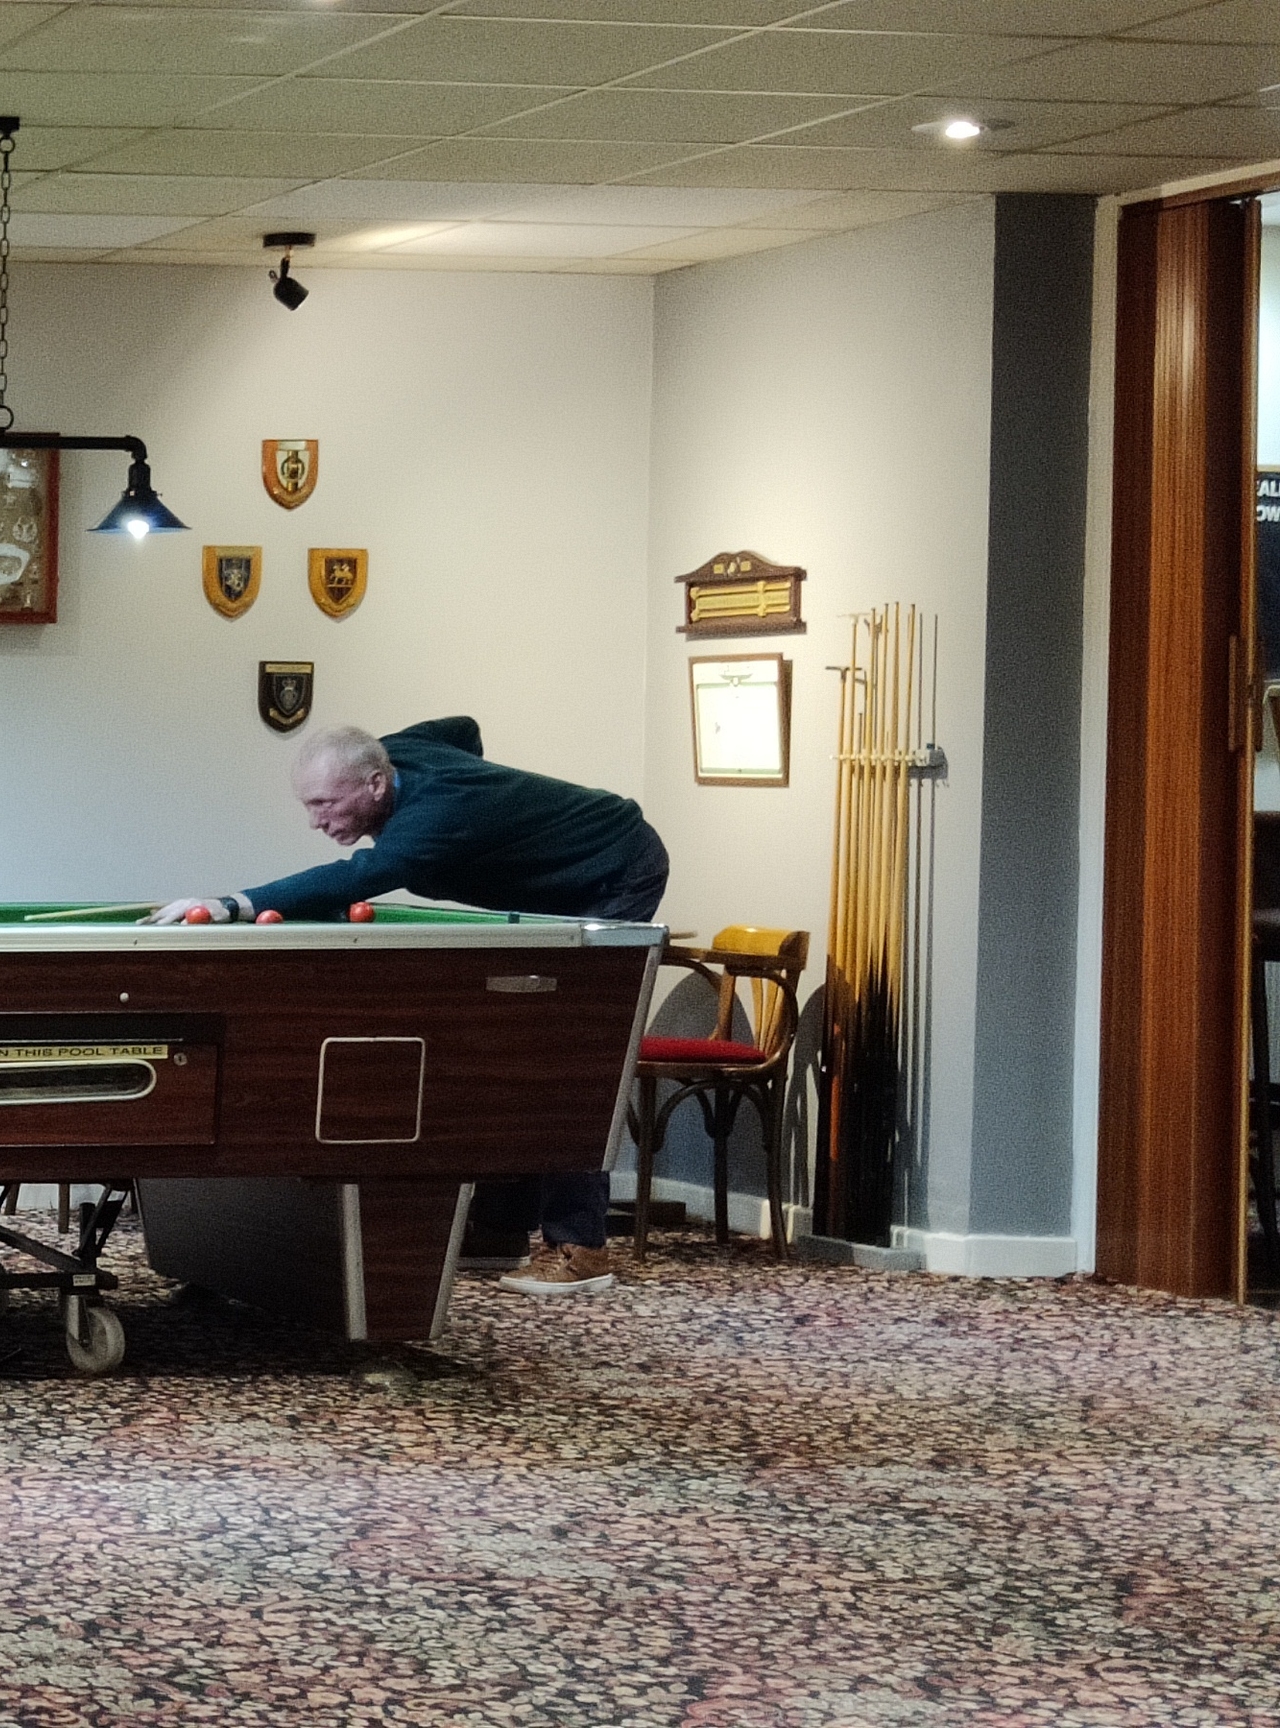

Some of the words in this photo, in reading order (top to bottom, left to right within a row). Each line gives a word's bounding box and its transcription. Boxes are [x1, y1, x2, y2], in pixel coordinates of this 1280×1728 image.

[16, 1048, 53, 1057] THIS
[58, 1047, 105, 1056] POOL
[110, 1047, 163, 1056] TABLE
